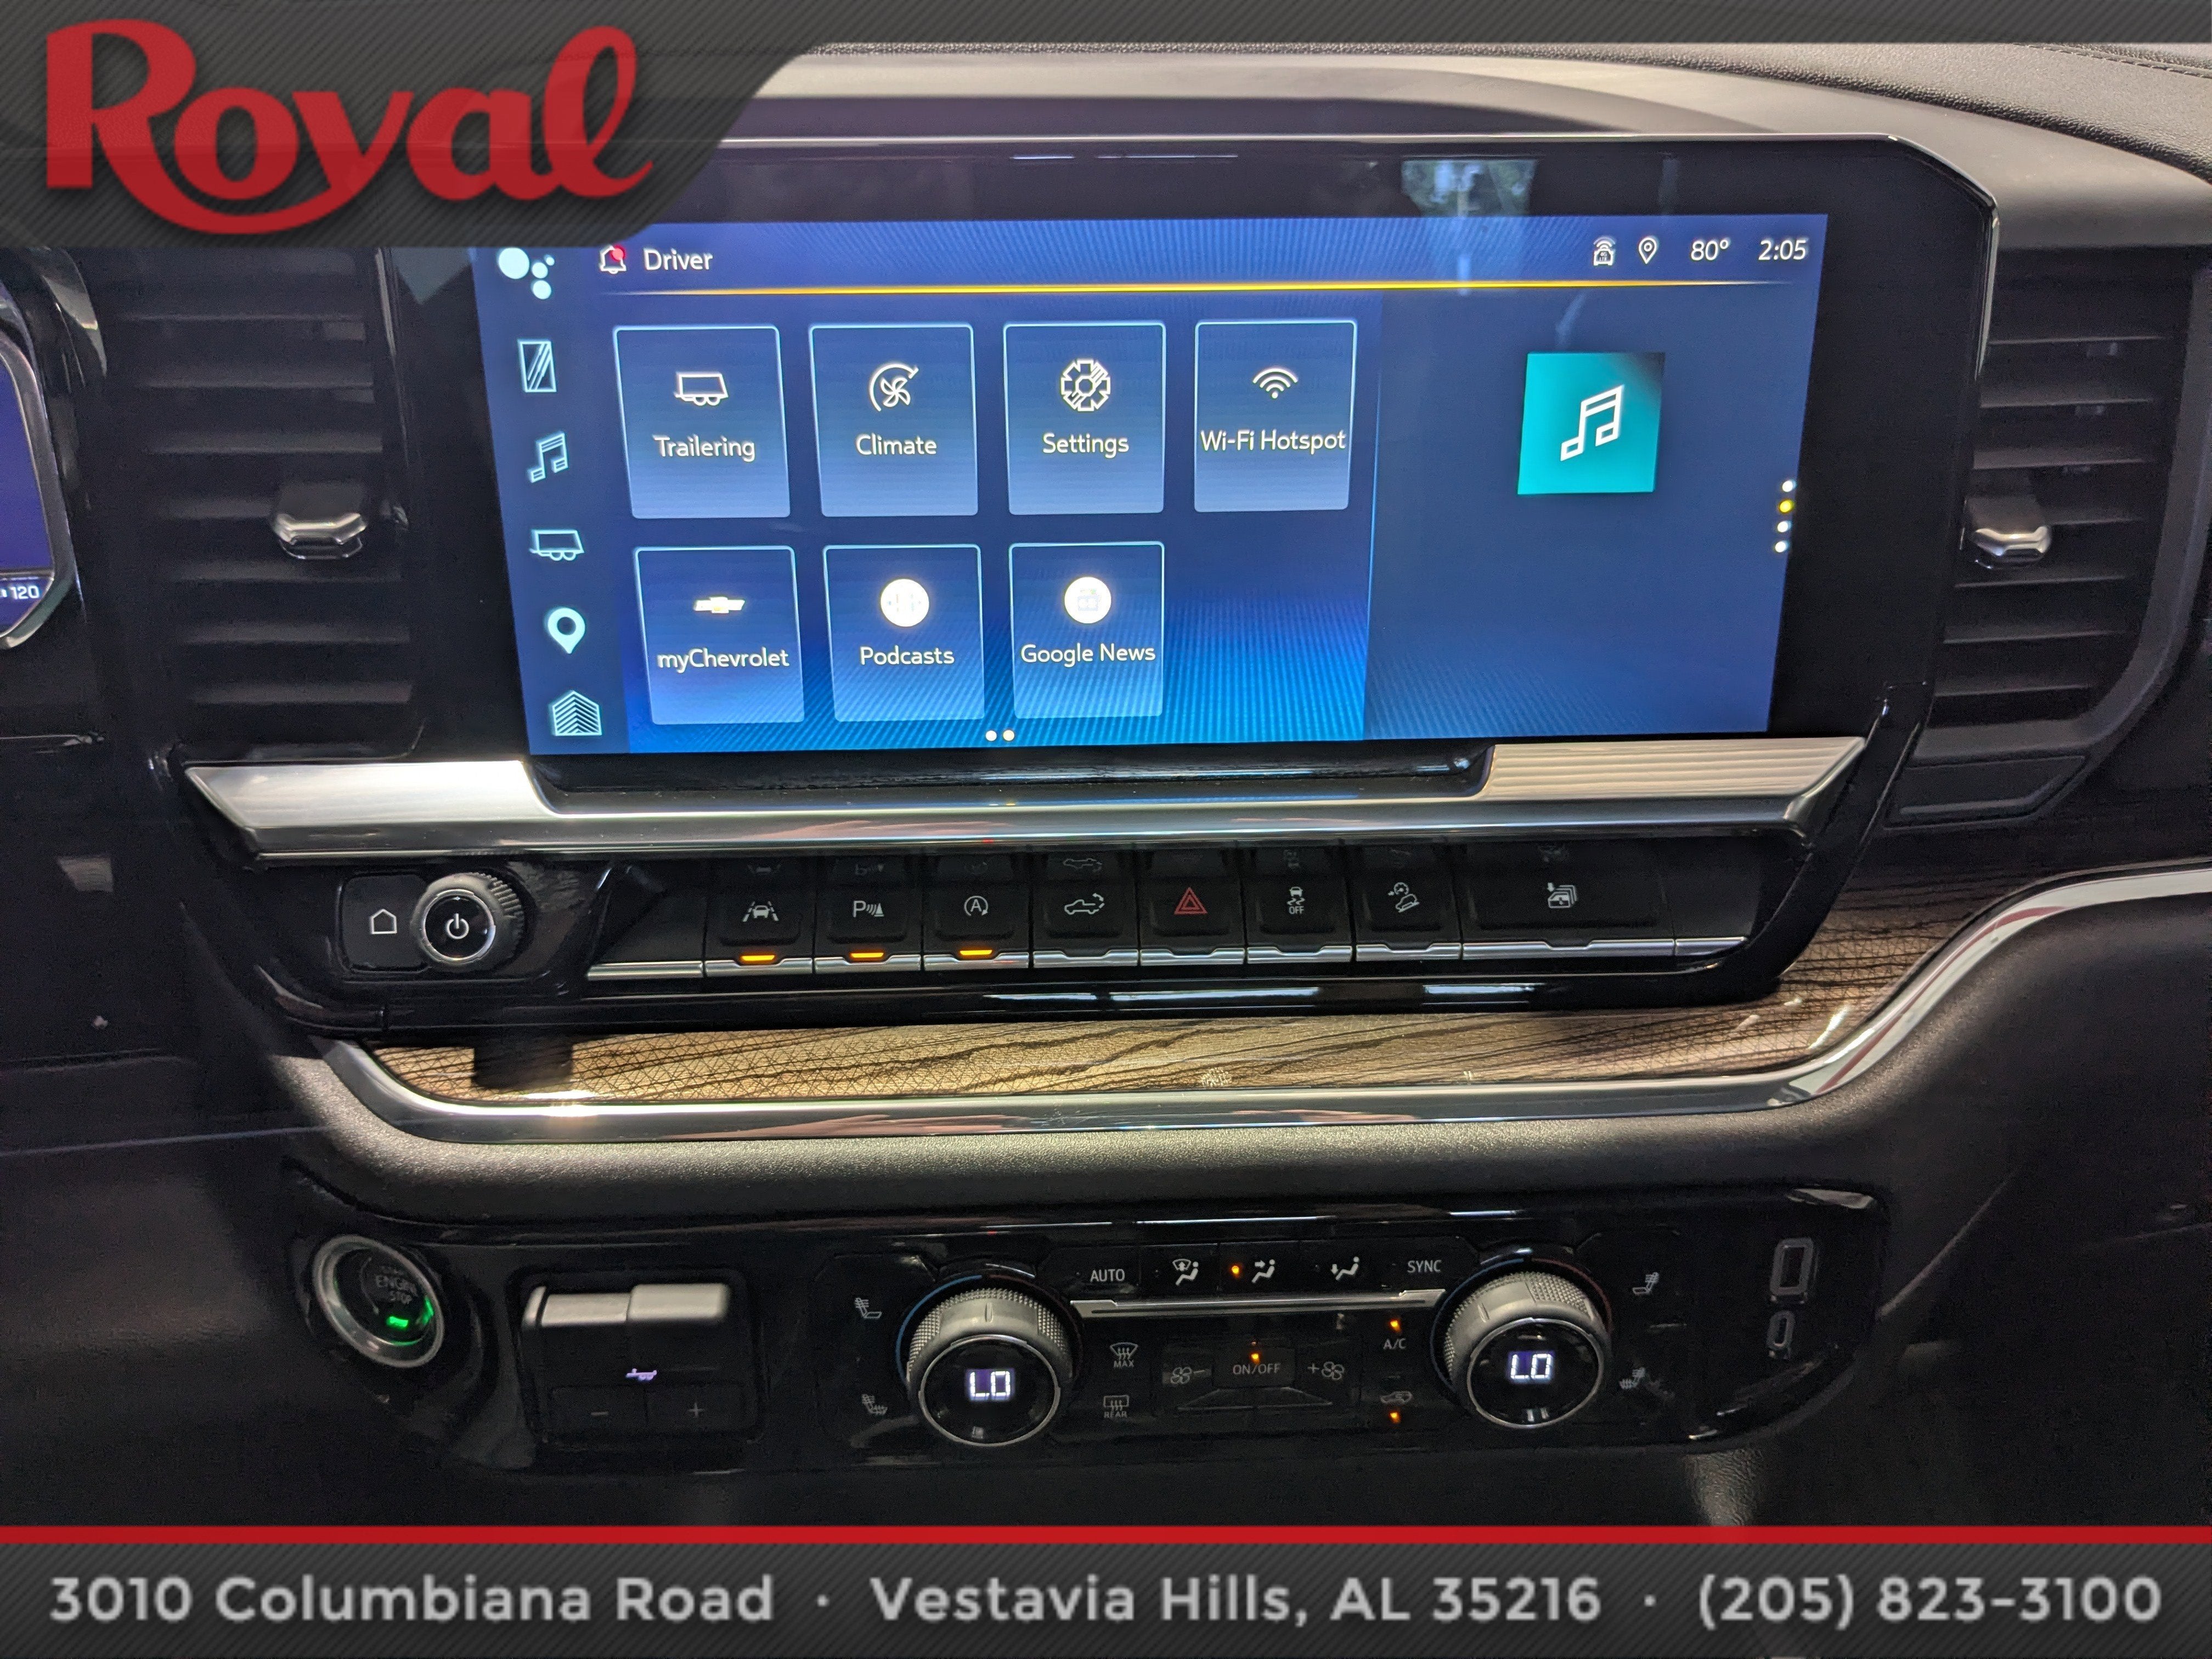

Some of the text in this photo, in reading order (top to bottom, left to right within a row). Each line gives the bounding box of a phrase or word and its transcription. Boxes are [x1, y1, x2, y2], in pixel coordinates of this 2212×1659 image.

[643, 248, 713, 270] Driver
[1690, 238, 1730, 261] 80°
[1758, 239, 1808, 261] 2:05
[652, 434, 755, 462] Trailering
[855, 433, 938, 455] Climate
[1042, 432, 1130, 459] Settings
[1200, 429, 1347, 455] Wi-Fi Hotspot
[9, 585, 40, 600] 120
[657, 647, 790, 674] myChevrolet
[859, 645, 955, 665] Podcasts
[1020, 642, 1156, 668] Google News
[1288, 906, 1305, 915] OFF
[1090, 1268, 1125, 1282] AUTO
[1407, 1260, 1442, 1273] SYNC
[1383, 1338, 1407, 1350] A/C
[1232, 1363, 1281, 1375] ON/OFF
